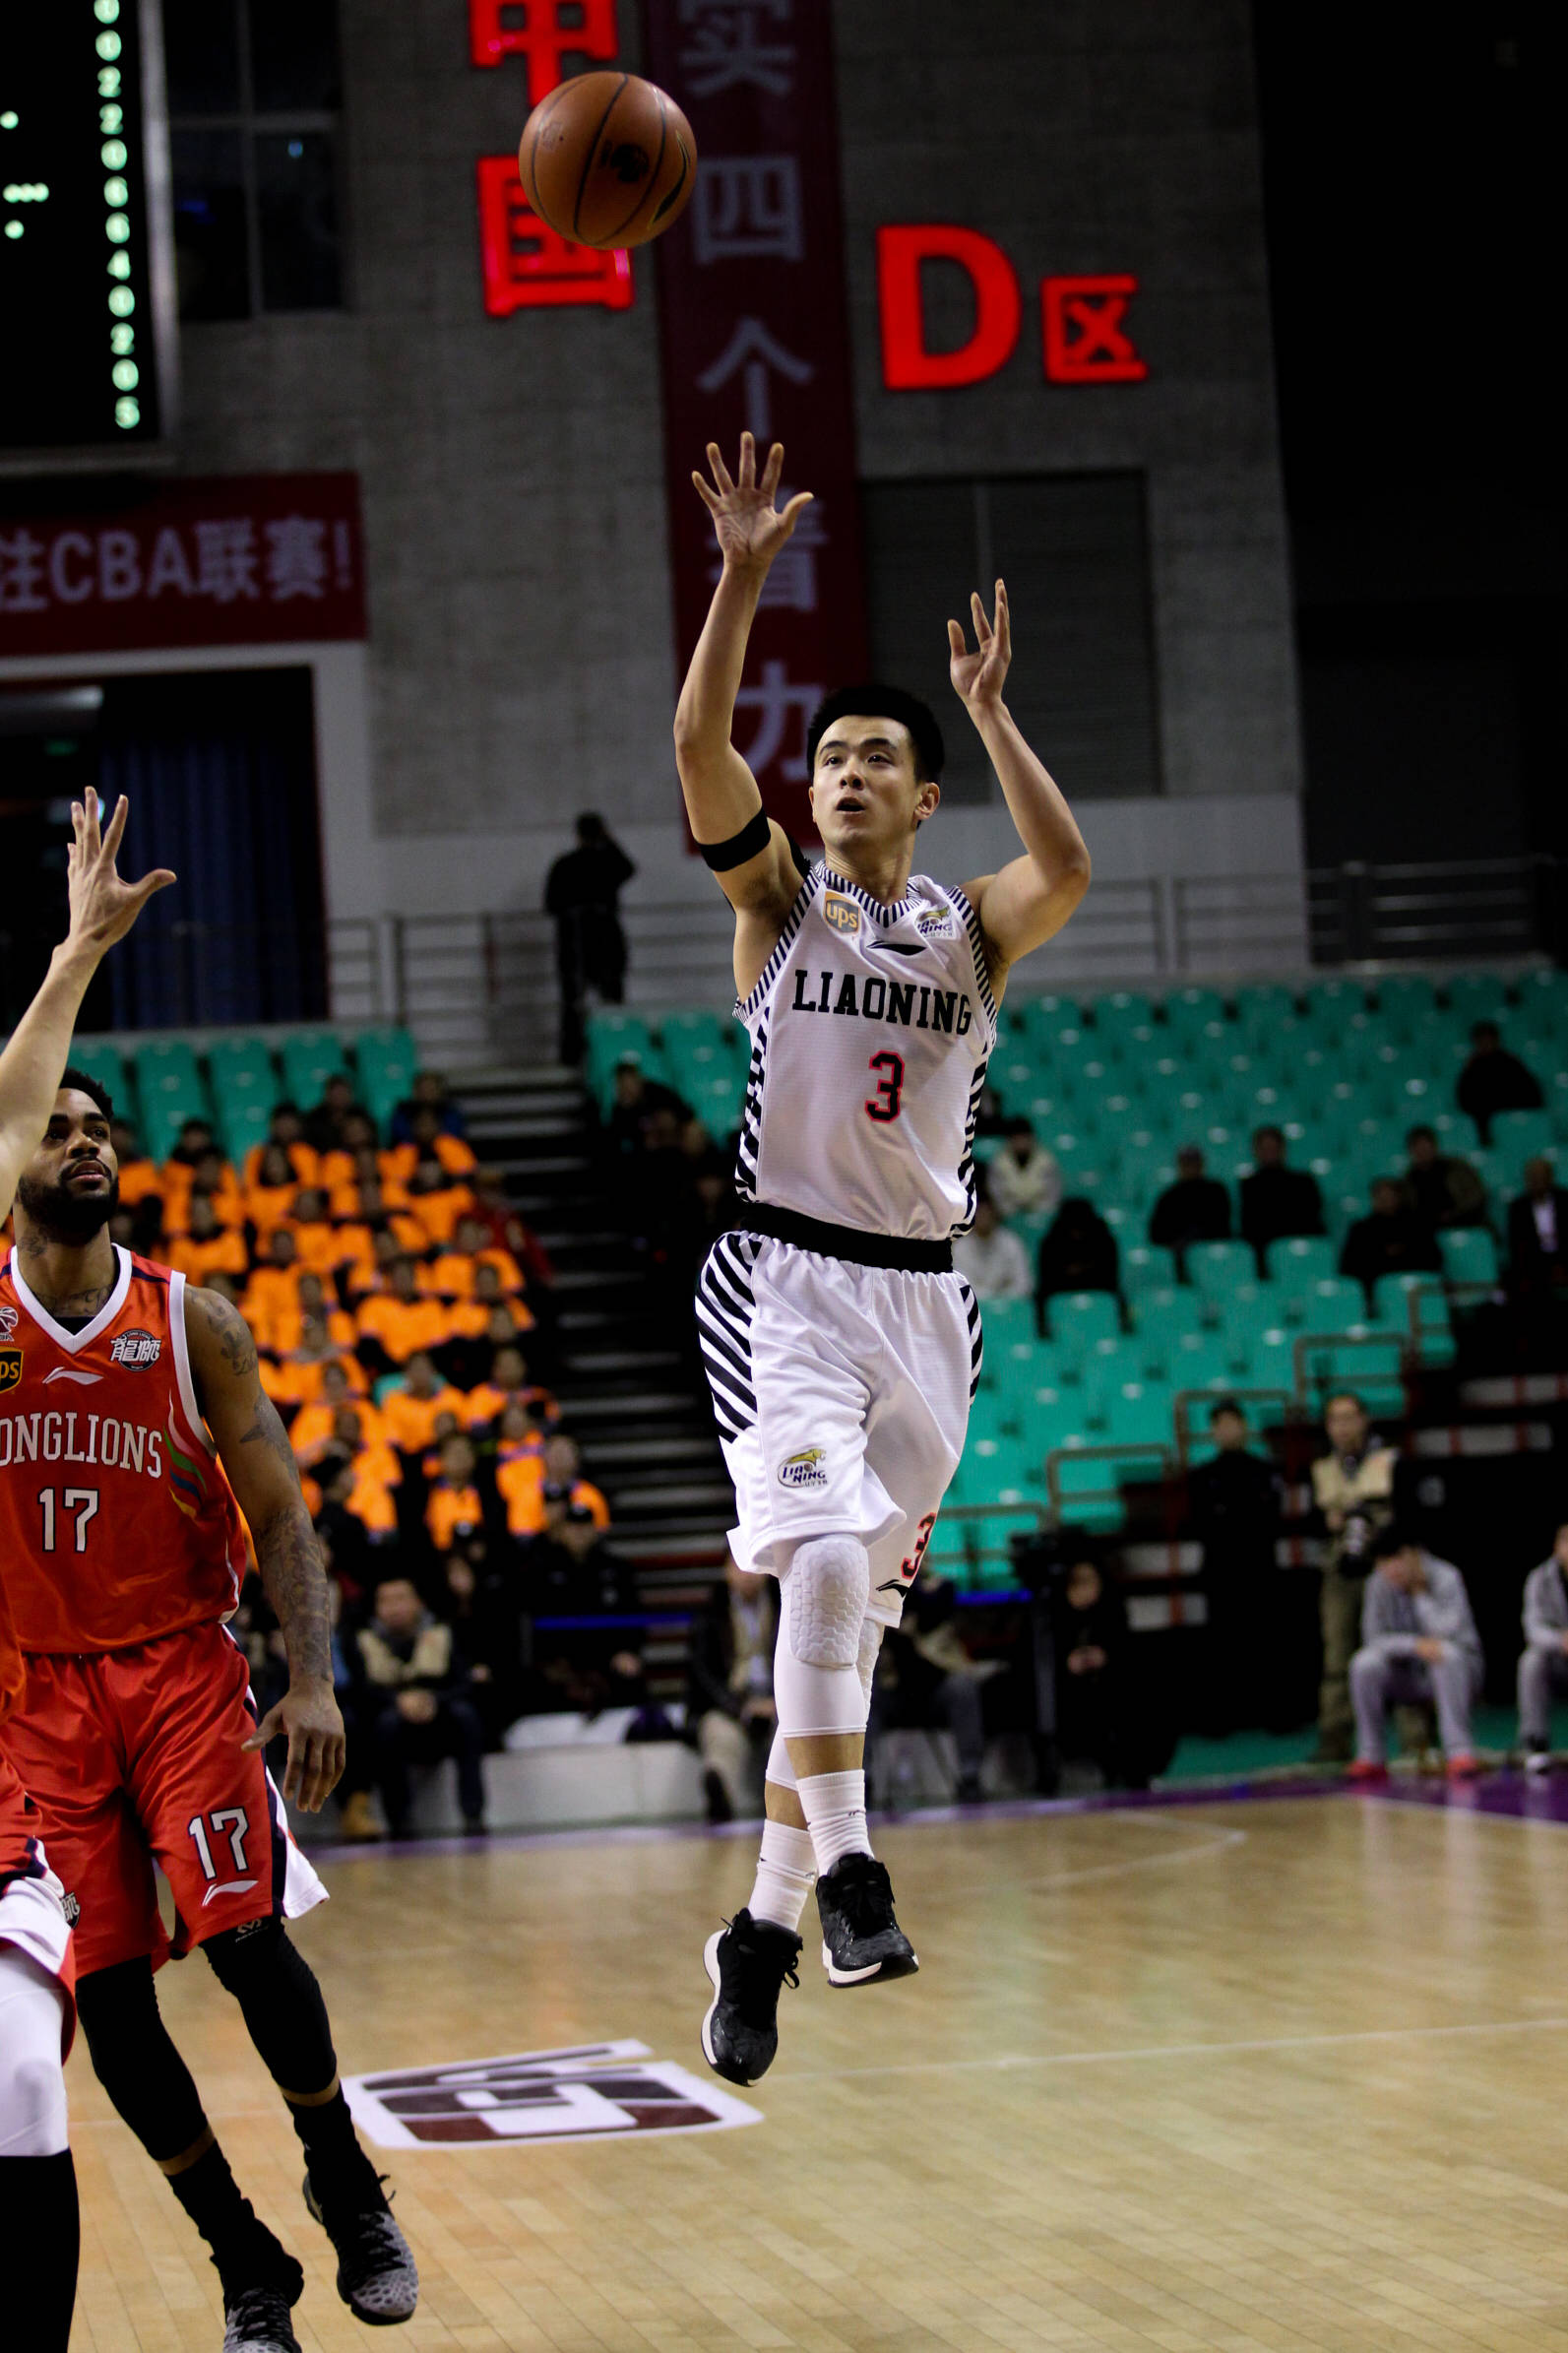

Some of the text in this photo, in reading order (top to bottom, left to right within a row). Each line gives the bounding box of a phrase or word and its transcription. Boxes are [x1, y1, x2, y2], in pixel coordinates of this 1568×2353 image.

[791, 969, 972, 1036] LIAONING
[864, 1049, 906, 1124] 3
[37, 1487, 100, 1553] 17
[900, 1511, 936, 1581] 3
[187, 1805, 250, 1881] 17
